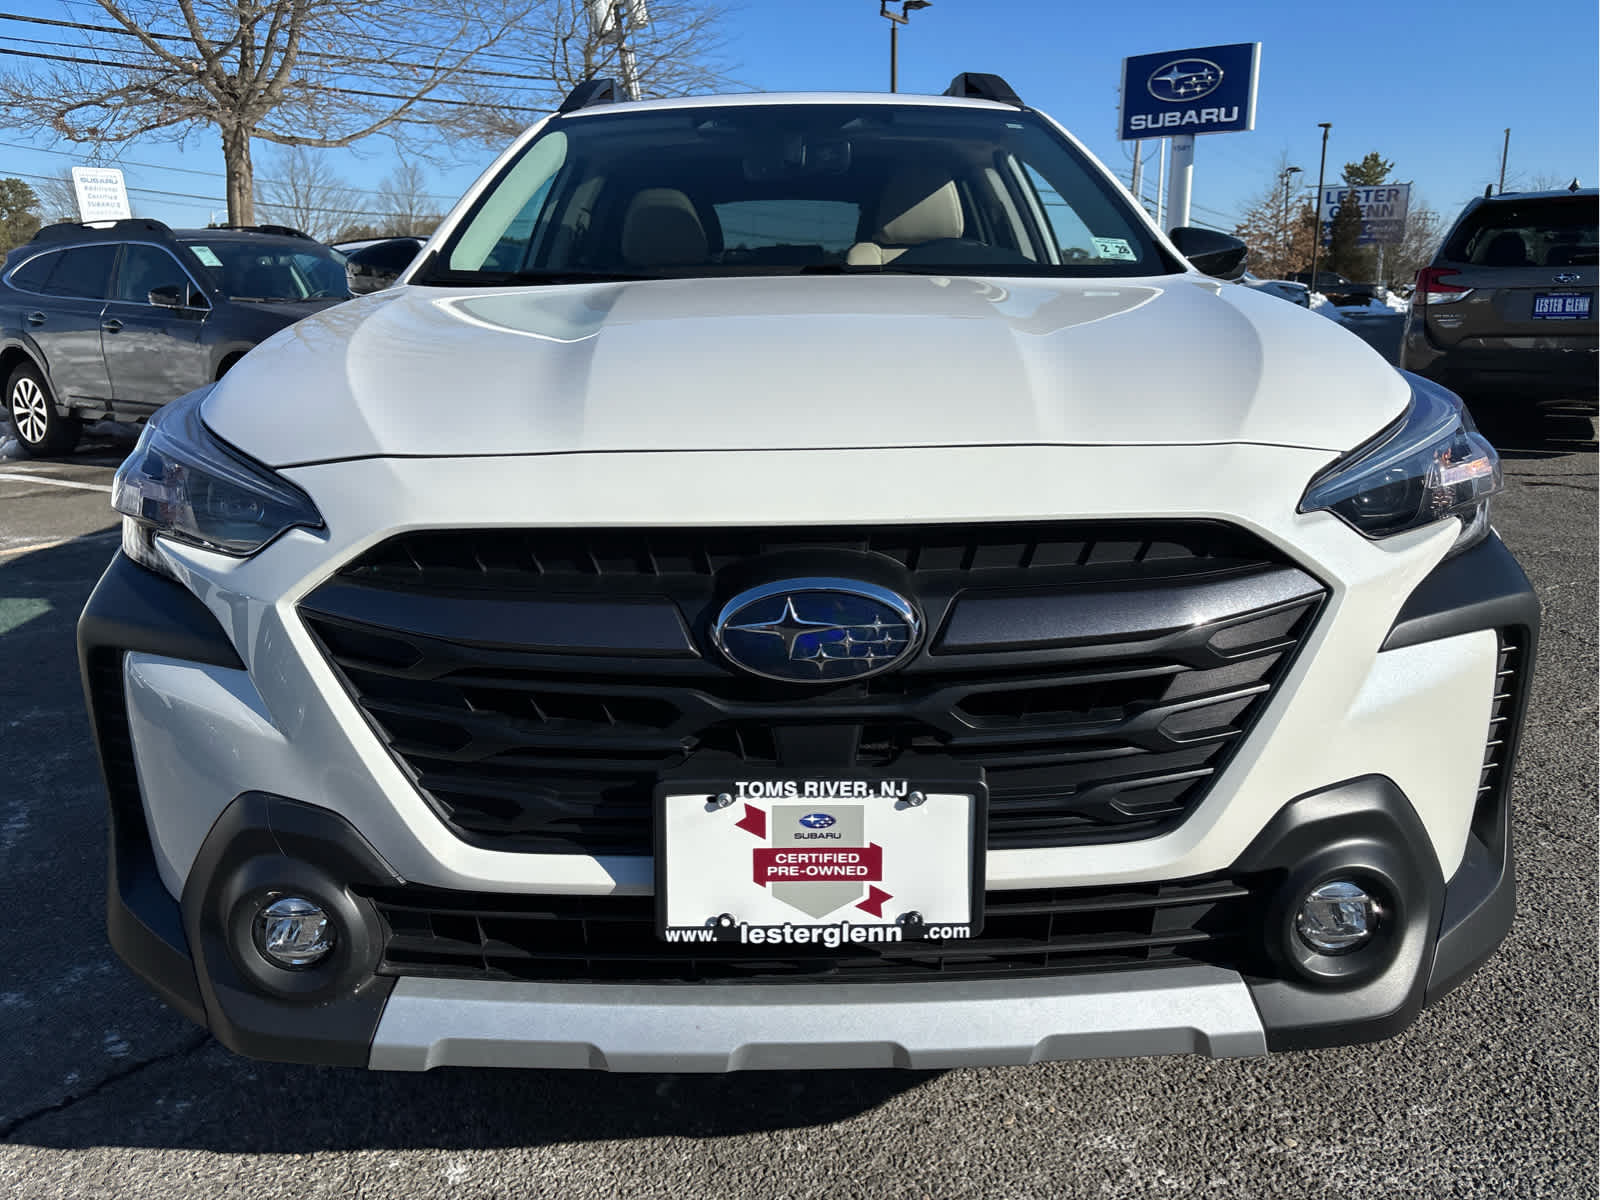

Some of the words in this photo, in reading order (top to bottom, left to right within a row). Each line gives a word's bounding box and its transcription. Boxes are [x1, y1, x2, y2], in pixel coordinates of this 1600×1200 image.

[1130, 106, 1239, 130] SUBARU
[1329, 204, 1394, 219] GENN
[1100, 244, 1110, 253] 2
[1535, 298, 1563, 313] LESTER
[1565, 297, 1590, 312] GLENN
[736, 781, 798, 797] TOMS
[804, 781, 874, 797] RIVER,
[881, 781, 908, 797] NJ
[794, 832, 841, 840] SUBARU
[775, 853, 860, 864] CERTIFIED
[767, 865, 868, 877] PRE-OWNED
[665, 928, 717, 942] www.
[740, 924, 902, 948] lesterglenn
[923, 924, 970, 939] .com
